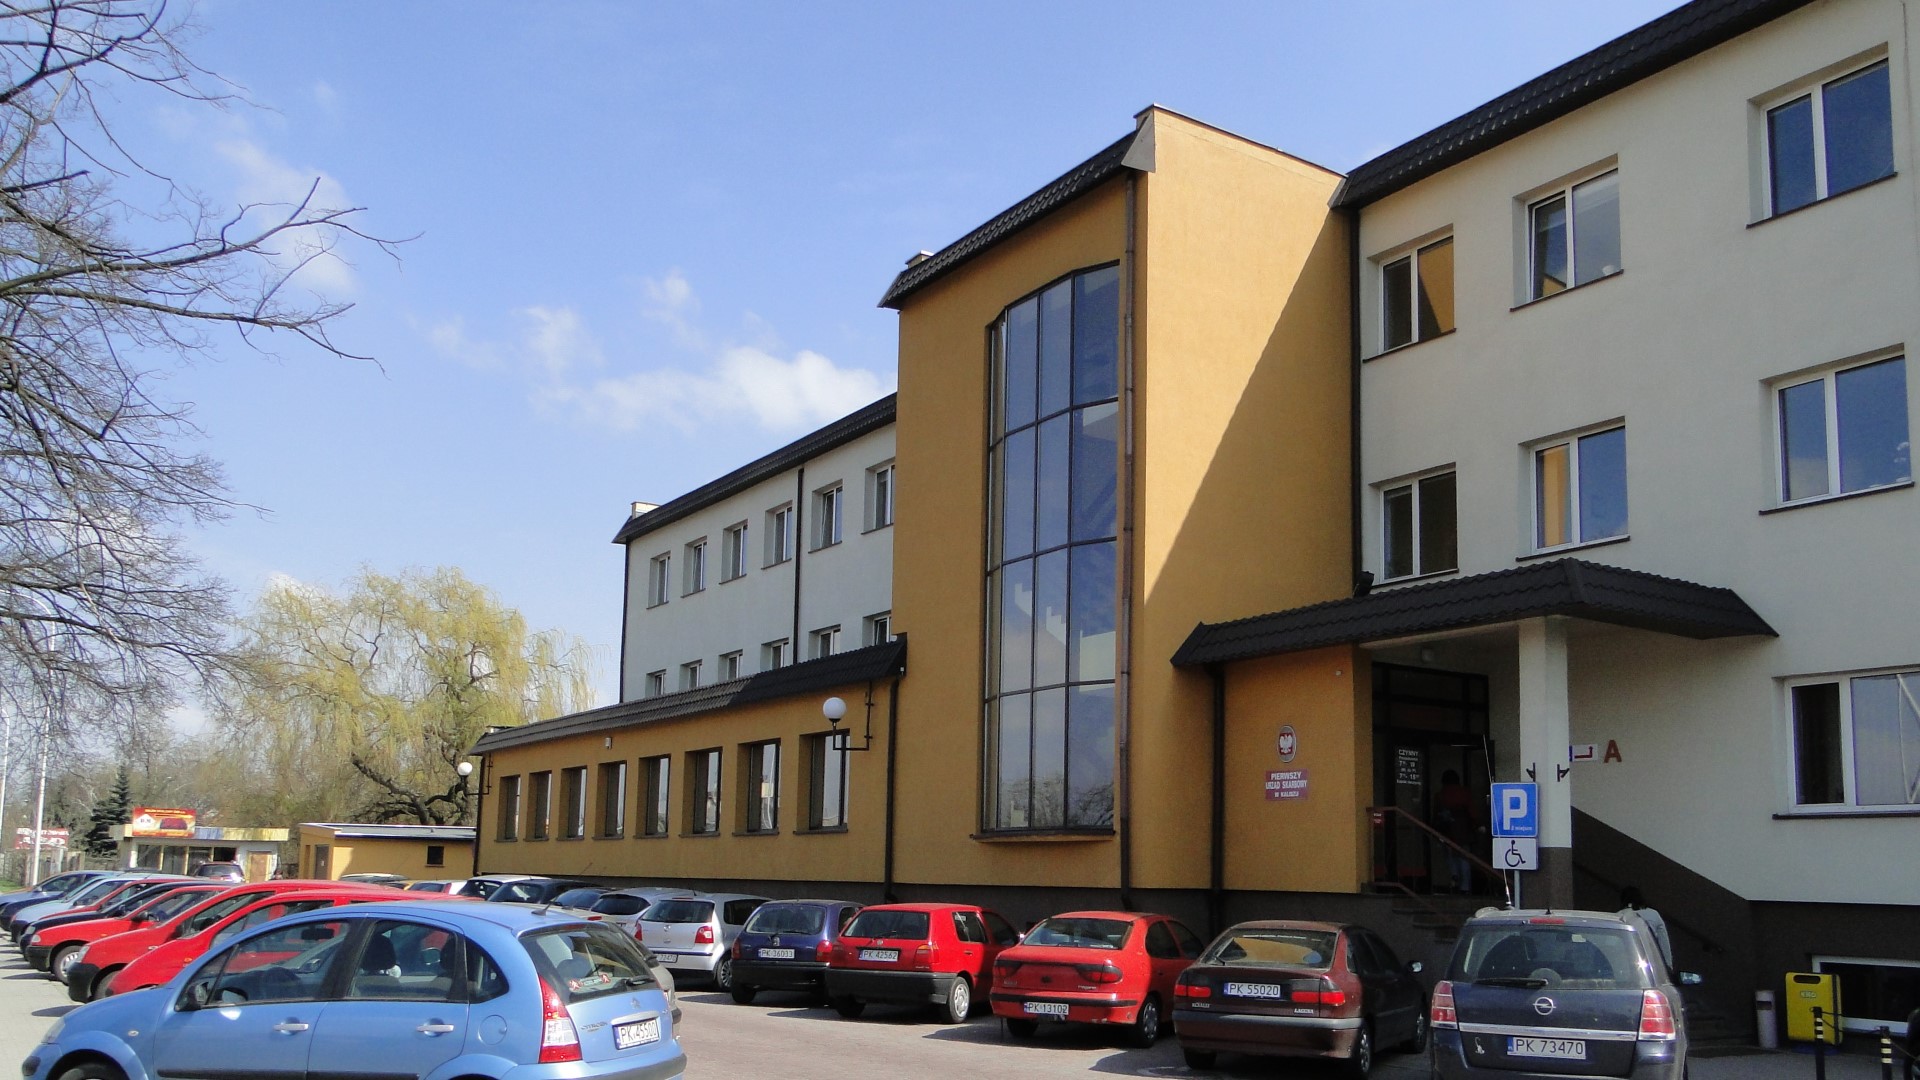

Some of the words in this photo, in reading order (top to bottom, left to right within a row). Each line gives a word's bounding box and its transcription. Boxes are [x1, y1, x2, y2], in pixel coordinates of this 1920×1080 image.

[1604, 739, 1622, 763] A
[1271, 771, 1302, 780] PIERWSZY
[1503, 789, 1527, 830] P
[760, 949, 771, 957] PK
[863, 951, 875, 959] PK
[875, 951, 898, 960] 42562
[1229, 984, 1244, 994] PK
[1247, 985, 1279, 996] 55020
[1028, 1003, 1040, 1012] PK
[1042, 1004, 1068, 1014] 13102
[620, 1025, 634, 1043] PK
[1515, 1039, 1535, 1052] PK
[1540, 1040, 1584, 1055] 73470
